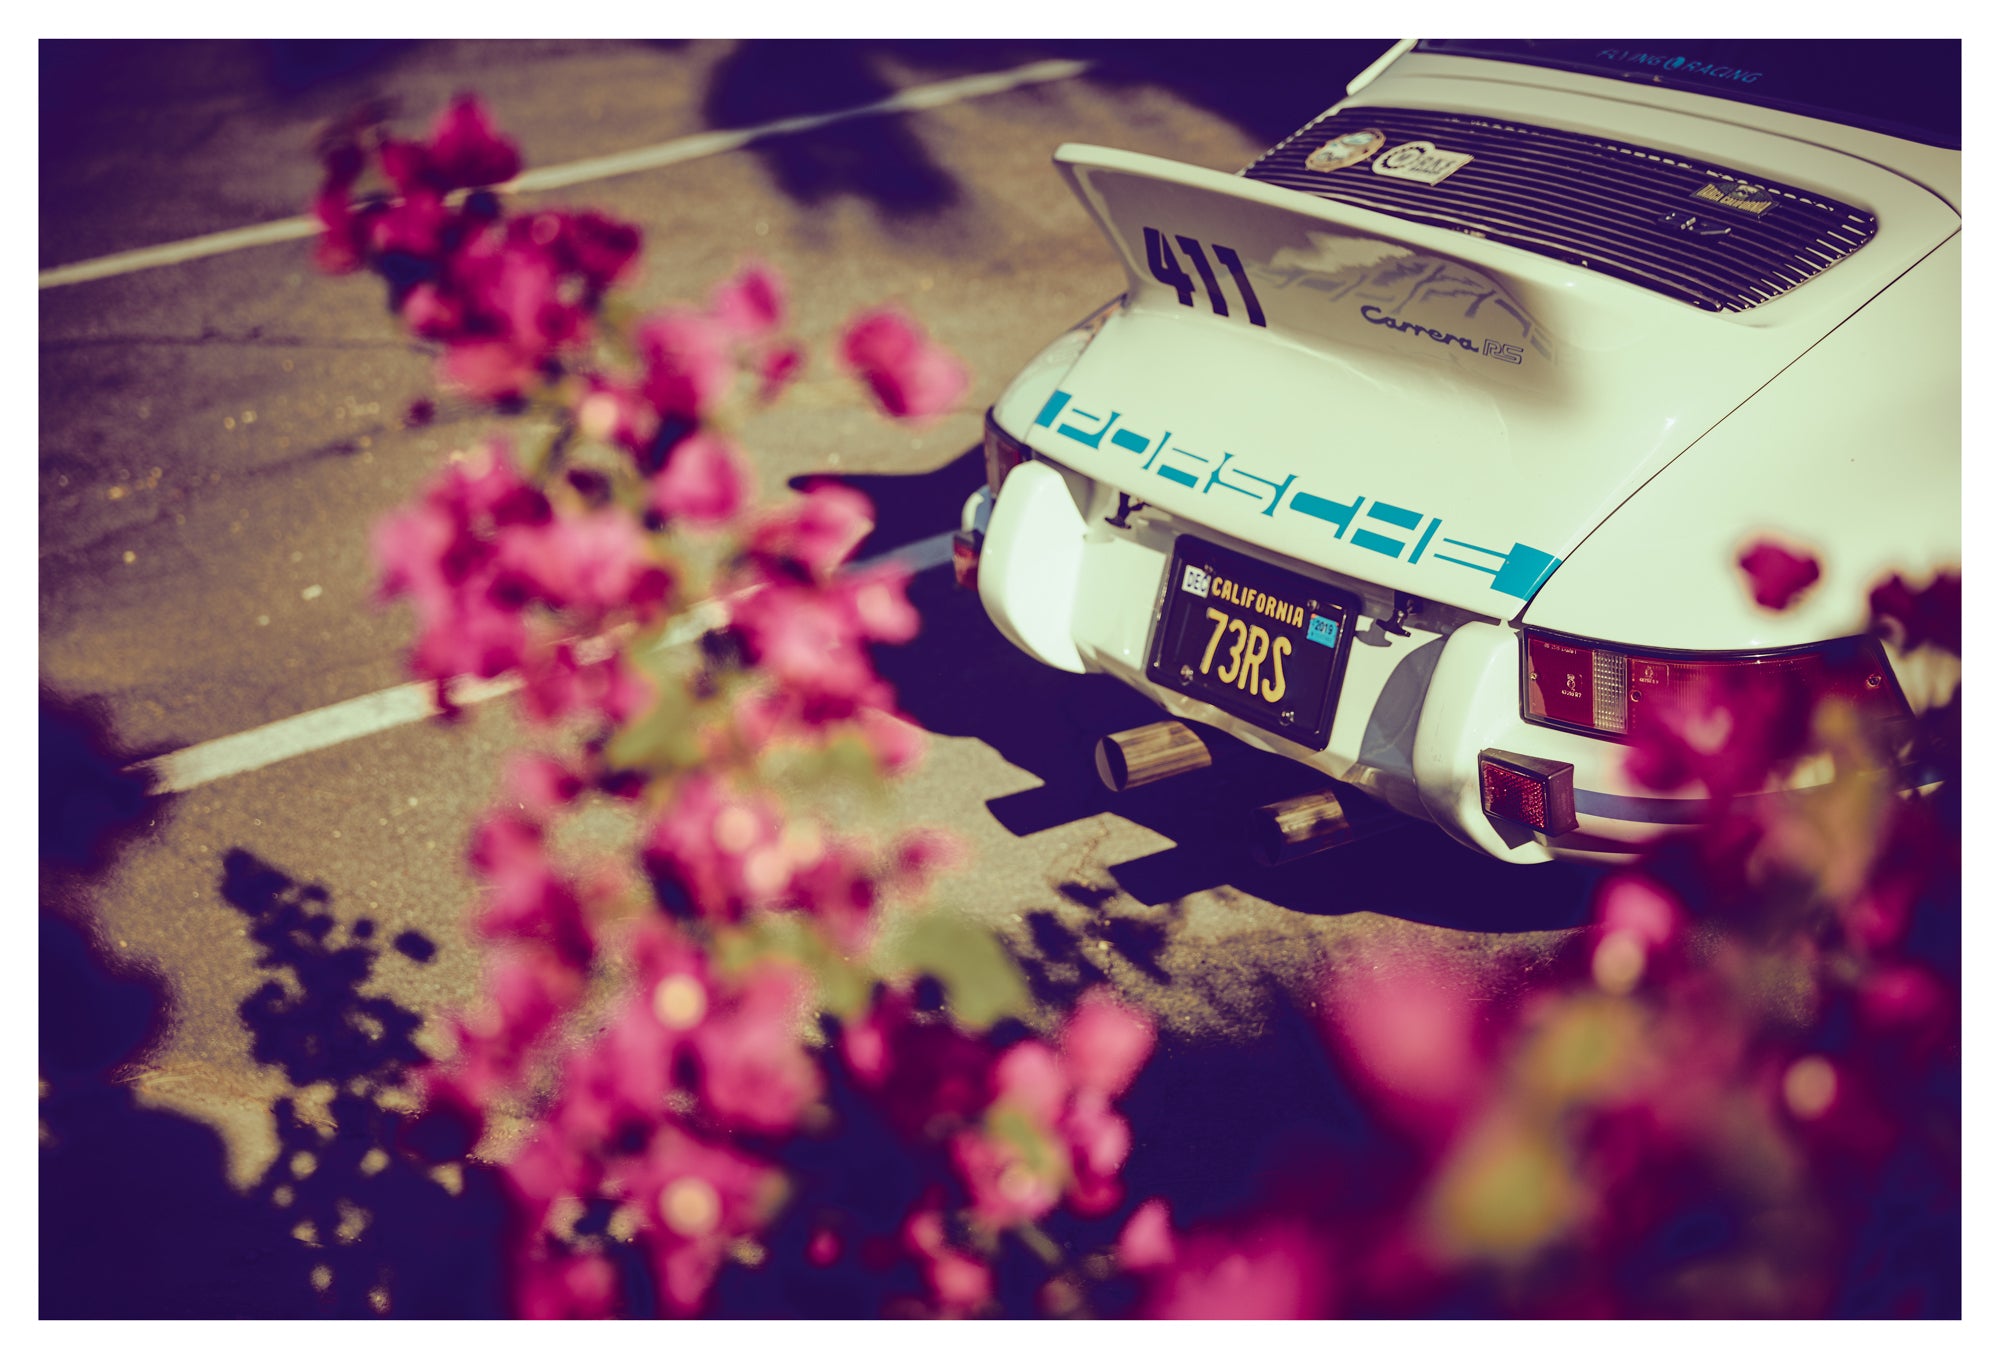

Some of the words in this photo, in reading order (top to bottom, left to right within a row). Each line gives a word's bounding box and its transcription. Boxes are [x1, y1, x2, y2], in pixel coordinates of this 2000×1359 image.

[1685, 61, 1764, 84] RACING
[1143, 226, 1267, 328] 411
[1360, 304, 1479, 353] Carrera
[1482, 338, 1524, 365] RS
[1034, 389, 1563, 602] PORSCHE
[1186, 570, 1210, 593] DEC
[1211, 576, 1305, 629] CALIFORNIA
[1200, 606, 1292, 703] 73RS
[1313, 618, 1334, 636] 2019
